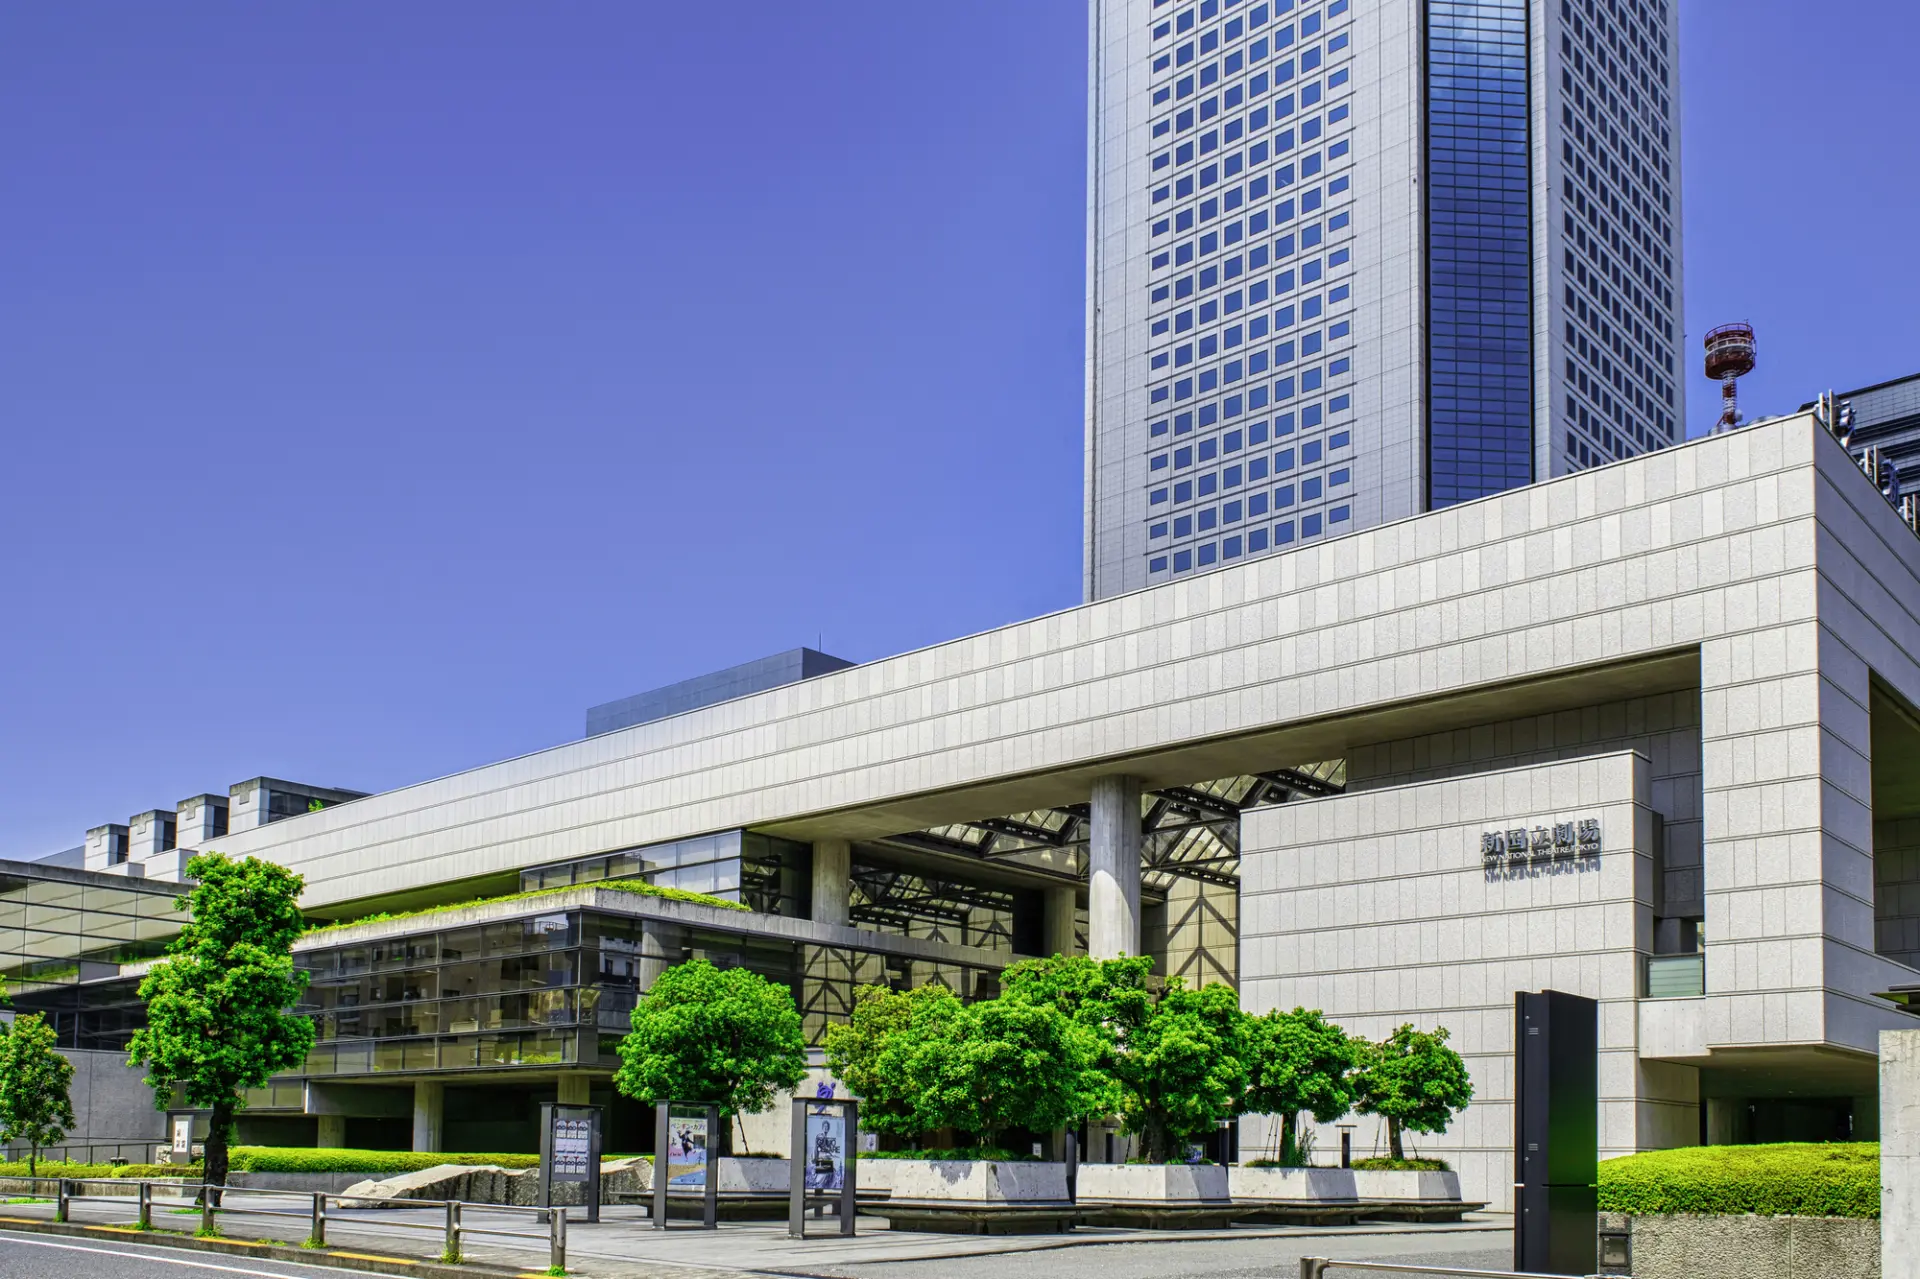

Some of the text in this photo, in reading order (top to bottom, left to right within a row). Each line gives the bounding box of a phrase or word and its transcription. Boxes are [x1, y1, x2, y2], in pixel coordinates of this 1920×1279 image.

[1481, 817, 1600, 853] 新国立劇場
[1499, 851, 1536, 860] NATIONAL
